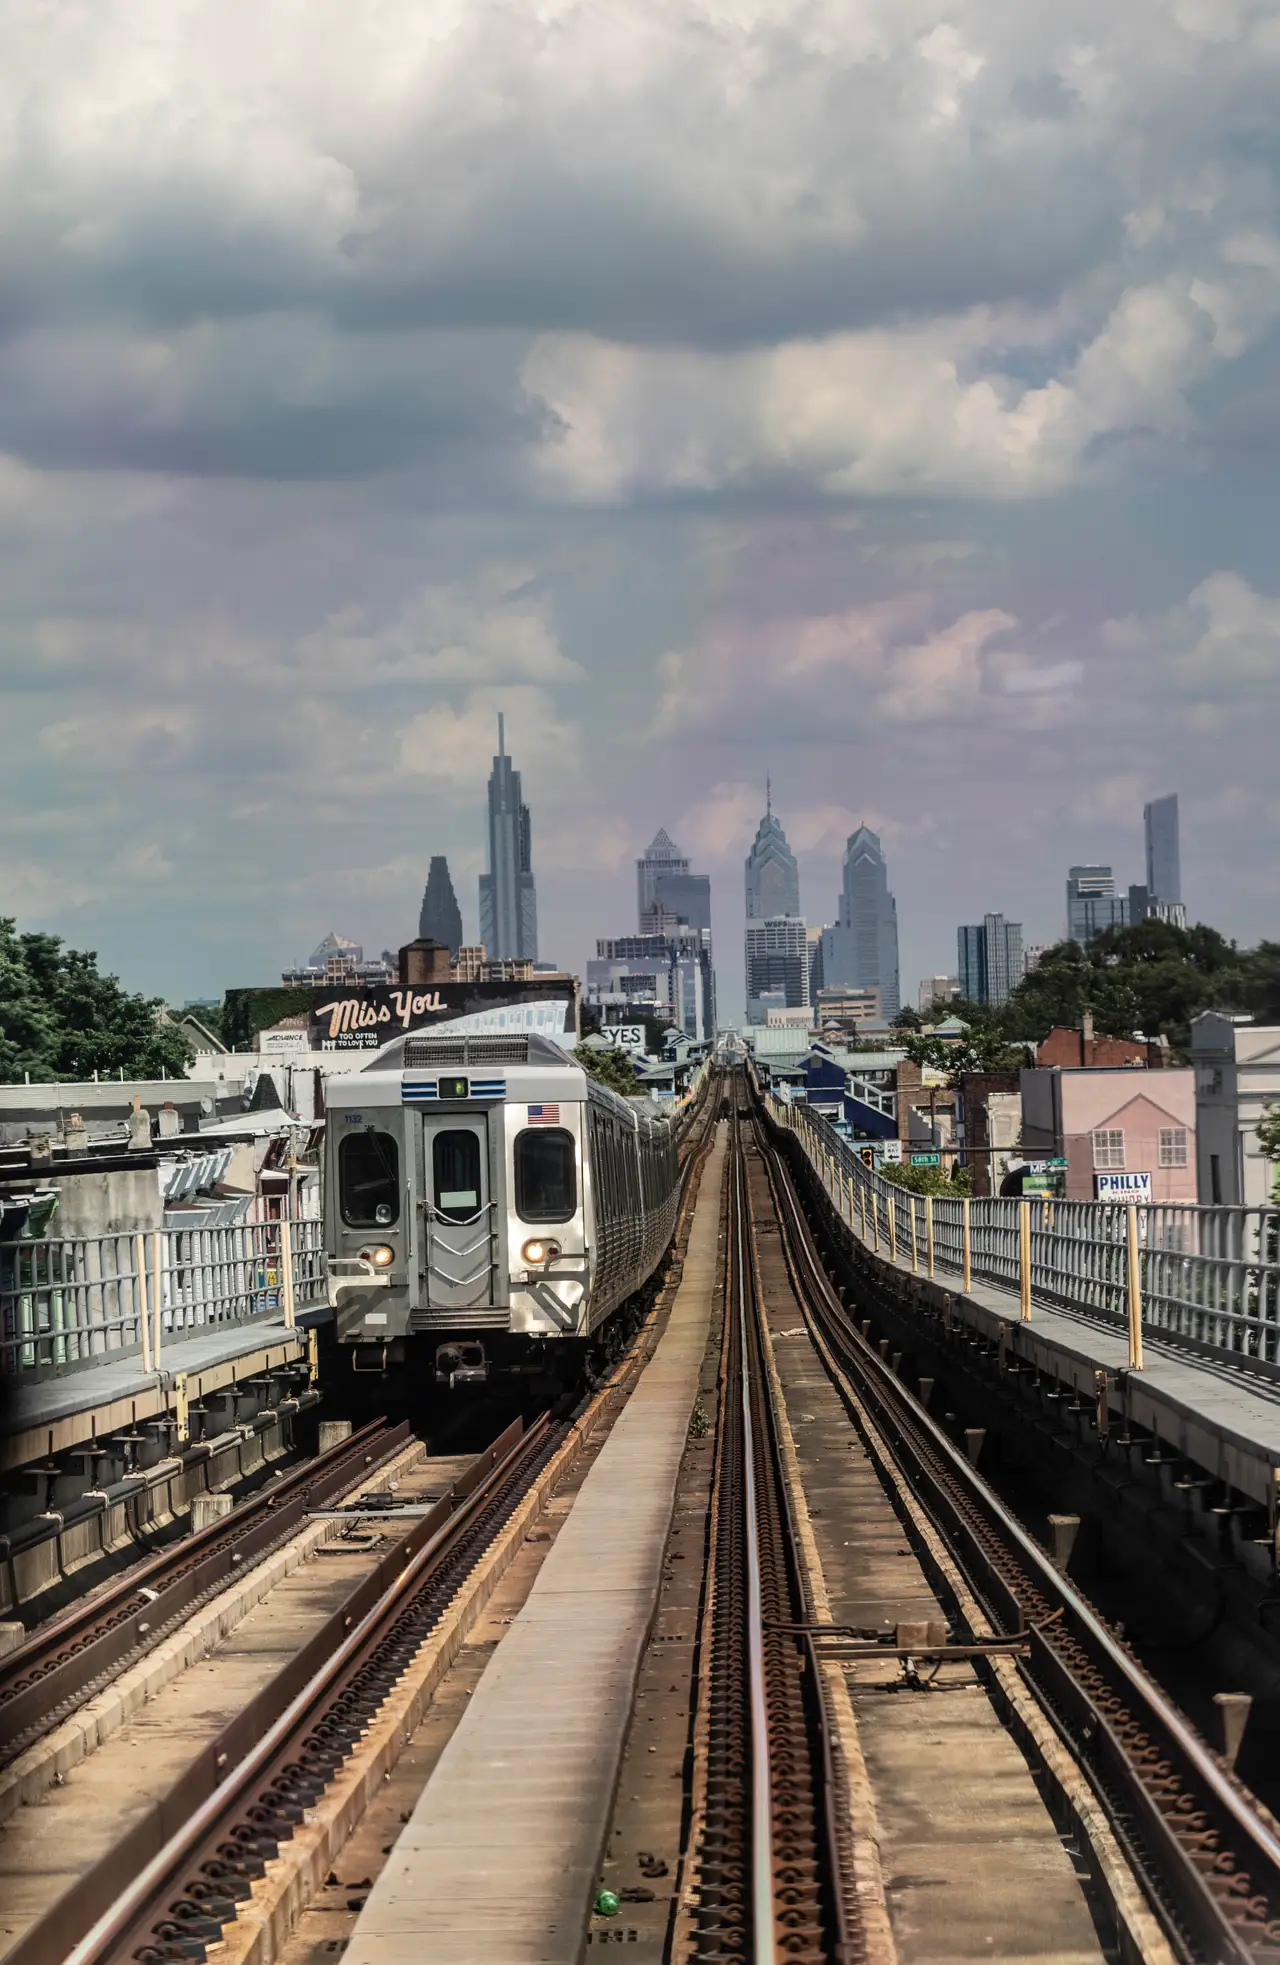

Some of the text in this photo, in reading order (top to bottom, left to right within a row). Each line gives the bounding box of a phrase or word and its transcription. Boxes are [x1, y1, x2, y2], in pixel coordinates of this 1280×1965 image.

[315, 991, 448, 1038] Miss You
[266, 1034, 304, 1042] ADVANCE
[355, 1032, 378, 1040] OFTEN
[345, 1114, 364, 1124] 1132
[1099, 1174, 1149, 1191] PHILLY
